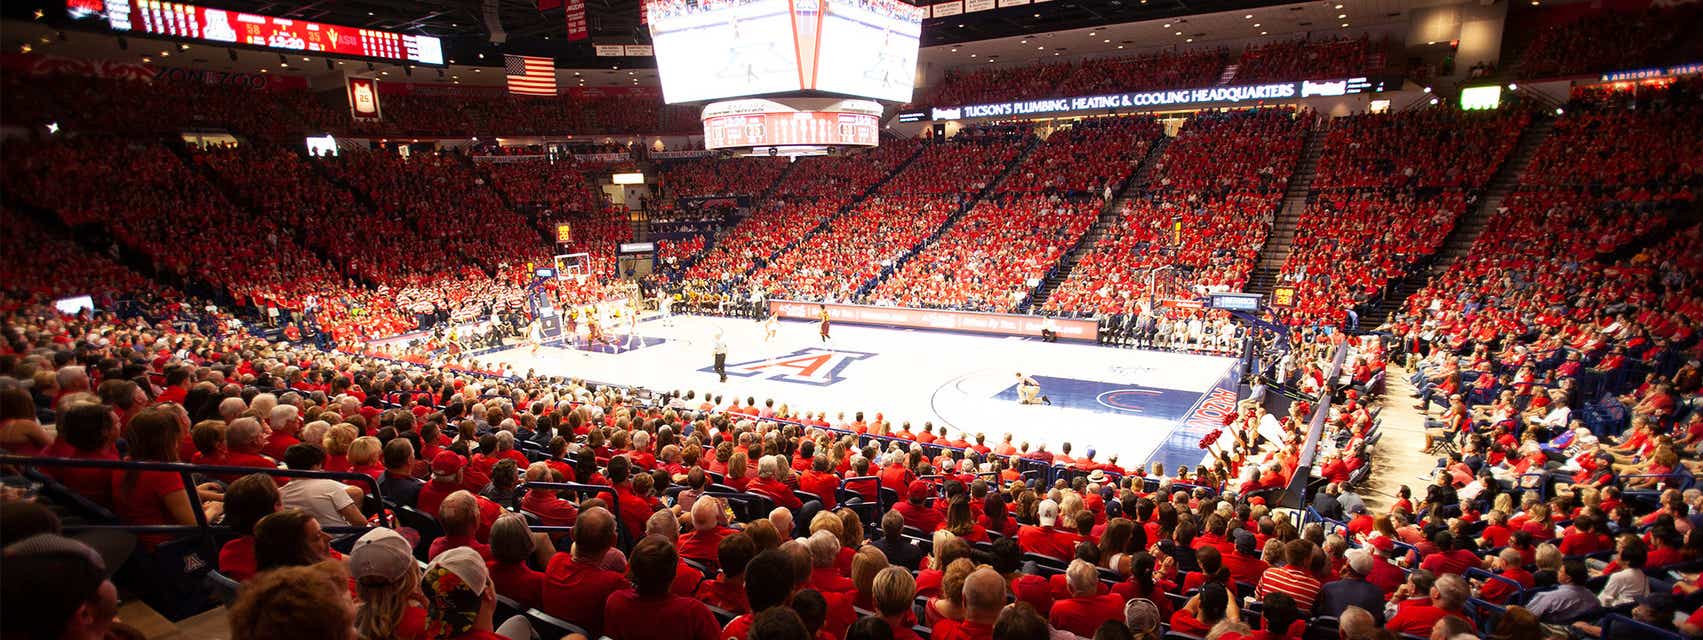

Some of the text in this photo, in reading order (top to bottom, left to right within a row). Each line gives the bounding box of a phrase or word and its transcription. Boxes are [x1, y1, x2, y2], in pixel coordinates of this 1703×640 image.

[965, 102, 1011, 117] TUCSON'S
[1013, 99, 1070, 114] PLUMBING,
[1072, 95, 1120, 110] HEATING
[1122, 94, 1133, 106] &
[1134, 90, 1190, 105] COOLING
[1192, 83, 1295, 102] HEADQUARTERS
